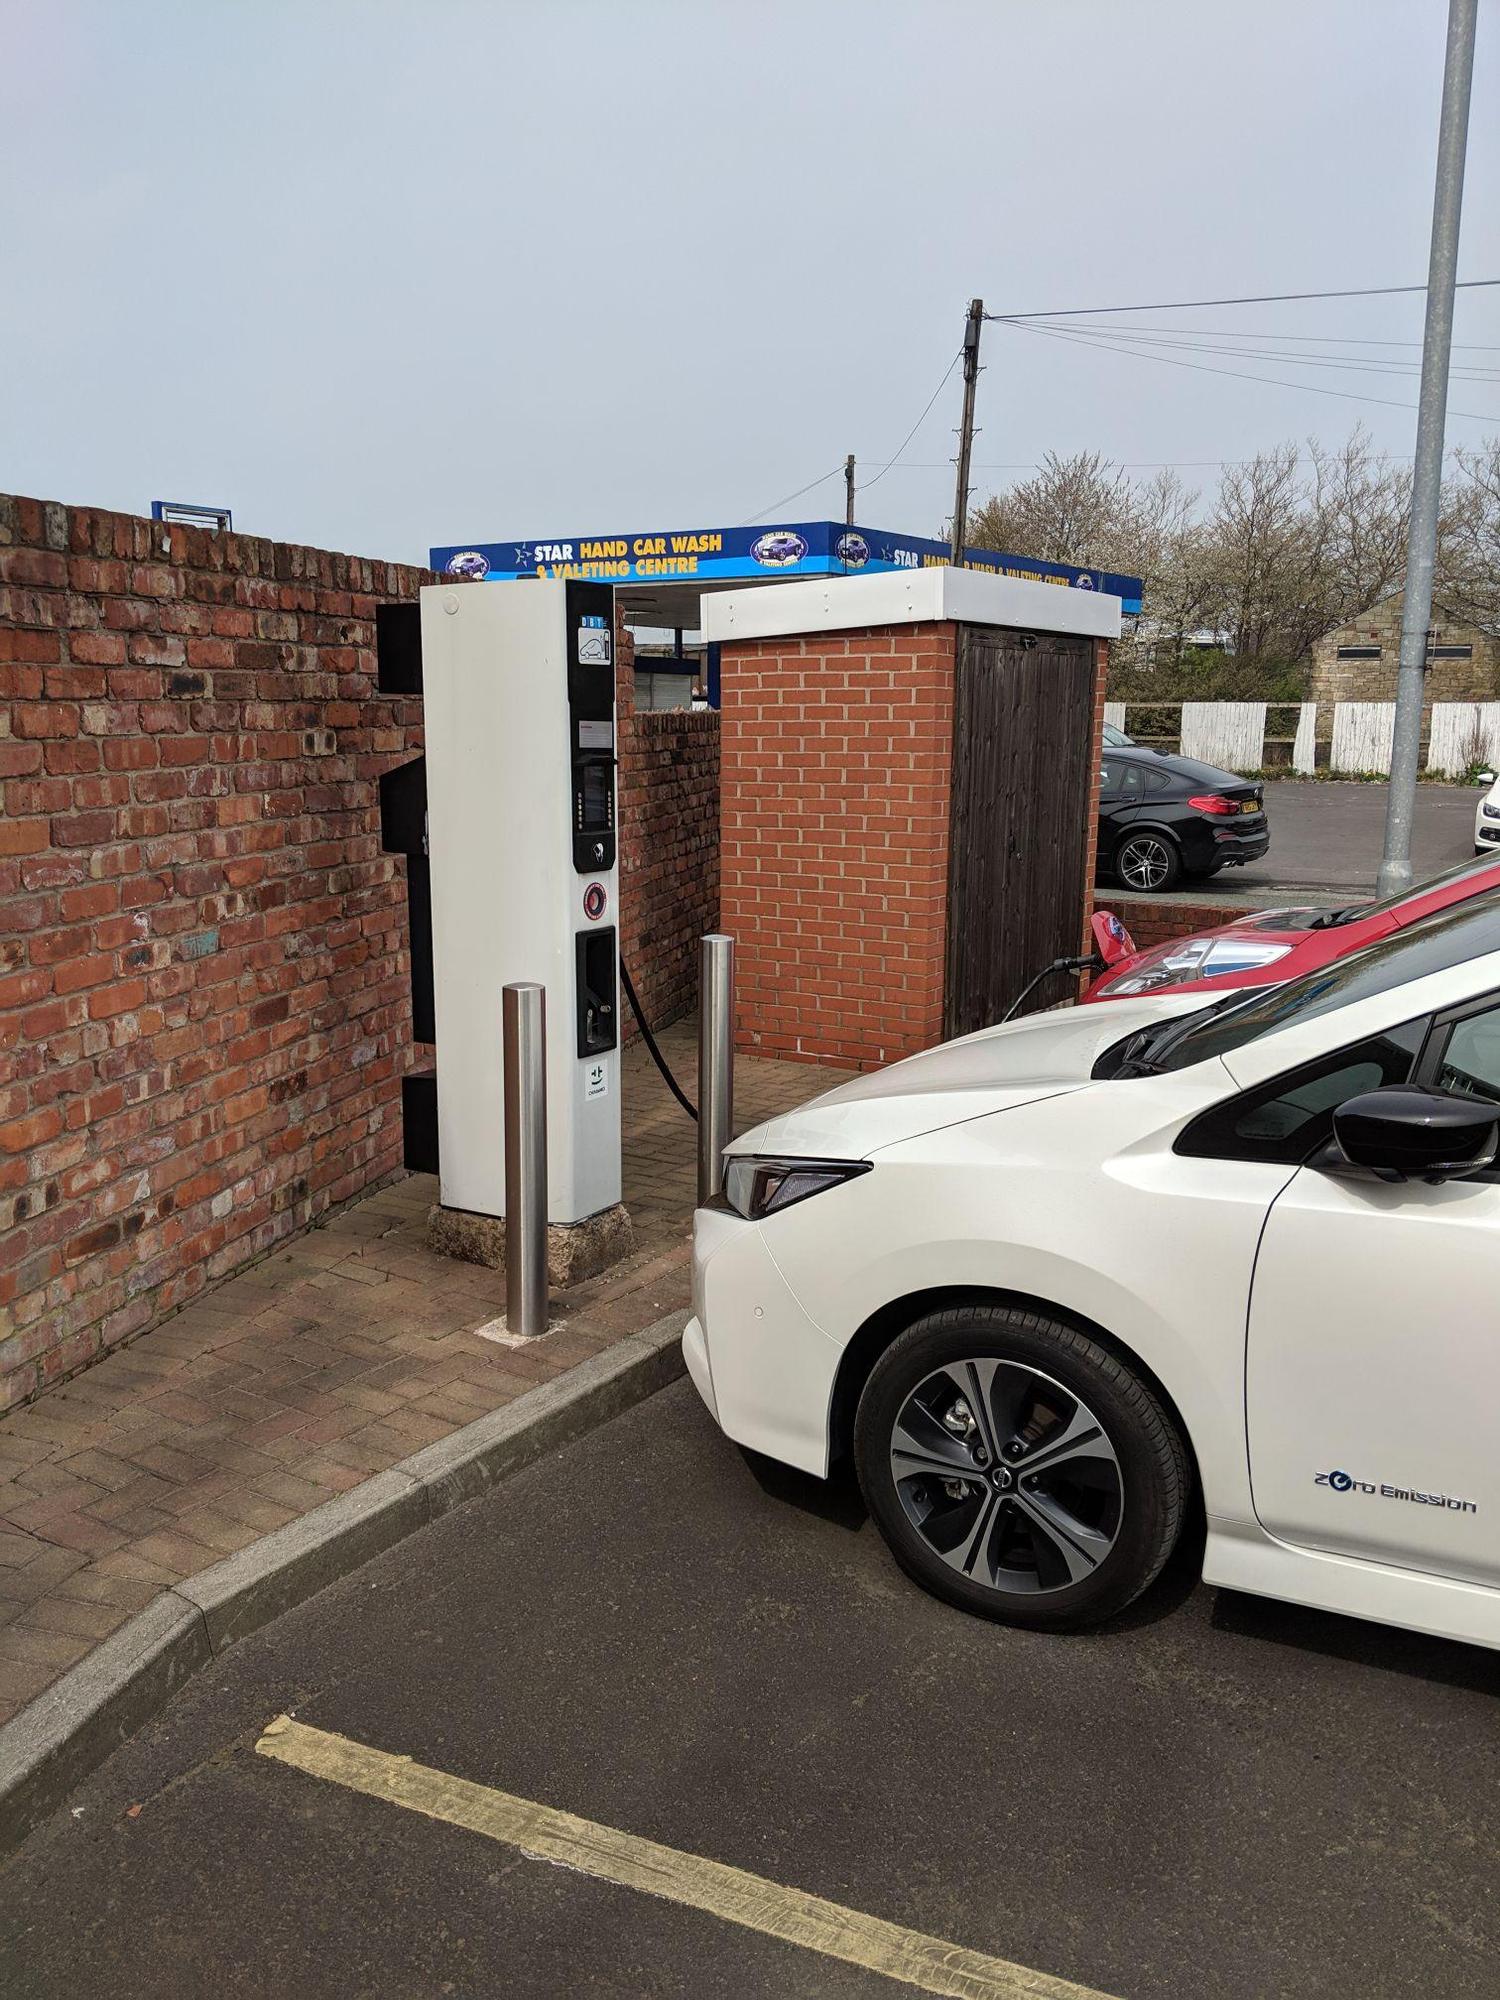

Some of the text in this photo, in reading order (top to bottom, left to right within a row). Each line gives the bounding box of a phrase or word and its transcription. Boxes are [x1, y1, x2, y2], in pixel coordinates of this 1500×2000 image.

[534, 534, 722, 562] STAR HAND CAR WASH
[893, 549, 918, 568] STAR
[536, 556, 698, 579] & VALETING CENTRE
[1381, 1483, 1477, 1513] Emission
